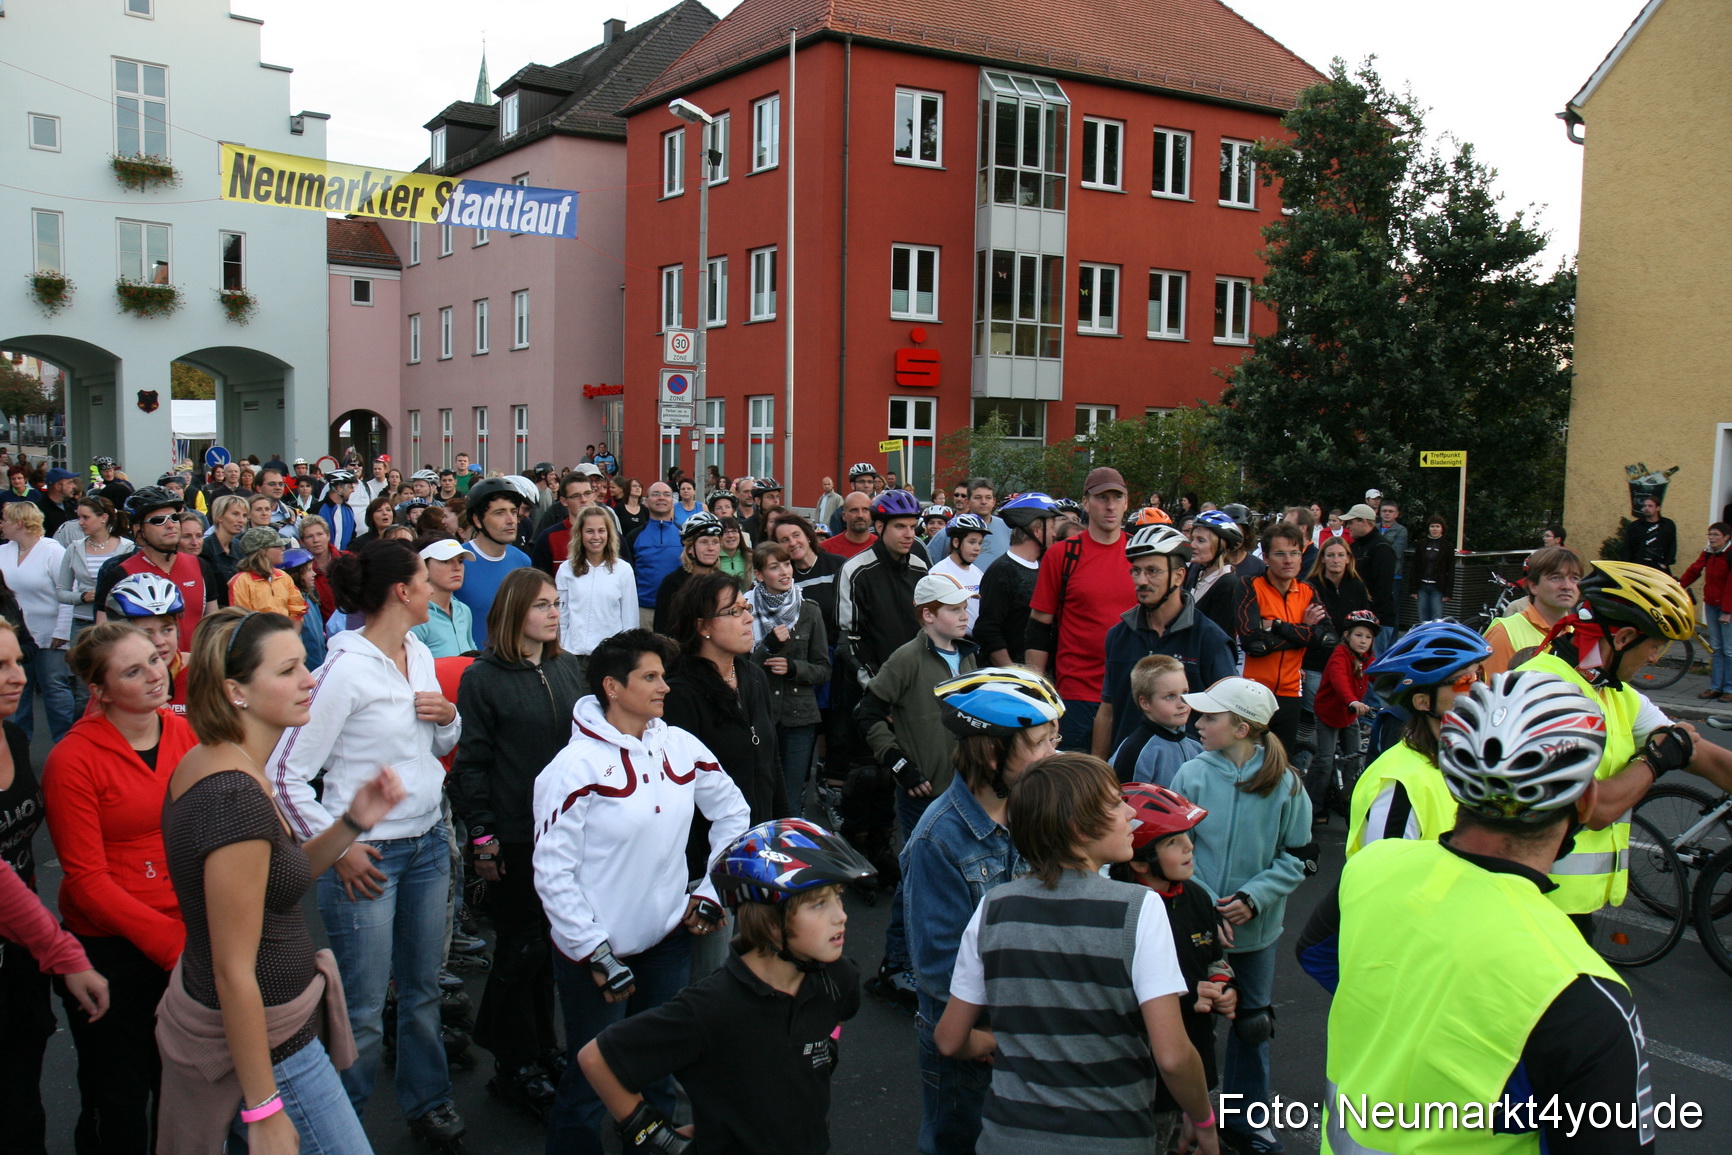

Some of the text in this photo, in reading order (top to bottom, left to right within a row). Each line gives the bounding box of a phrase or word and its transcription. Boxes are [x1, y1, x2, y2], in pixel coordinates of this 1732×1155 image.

[229, 152, 572, 236] Neumarkter Stadtlauf
[675, 339, 686, 348] 30
[957, 711, 991, 729] MET
